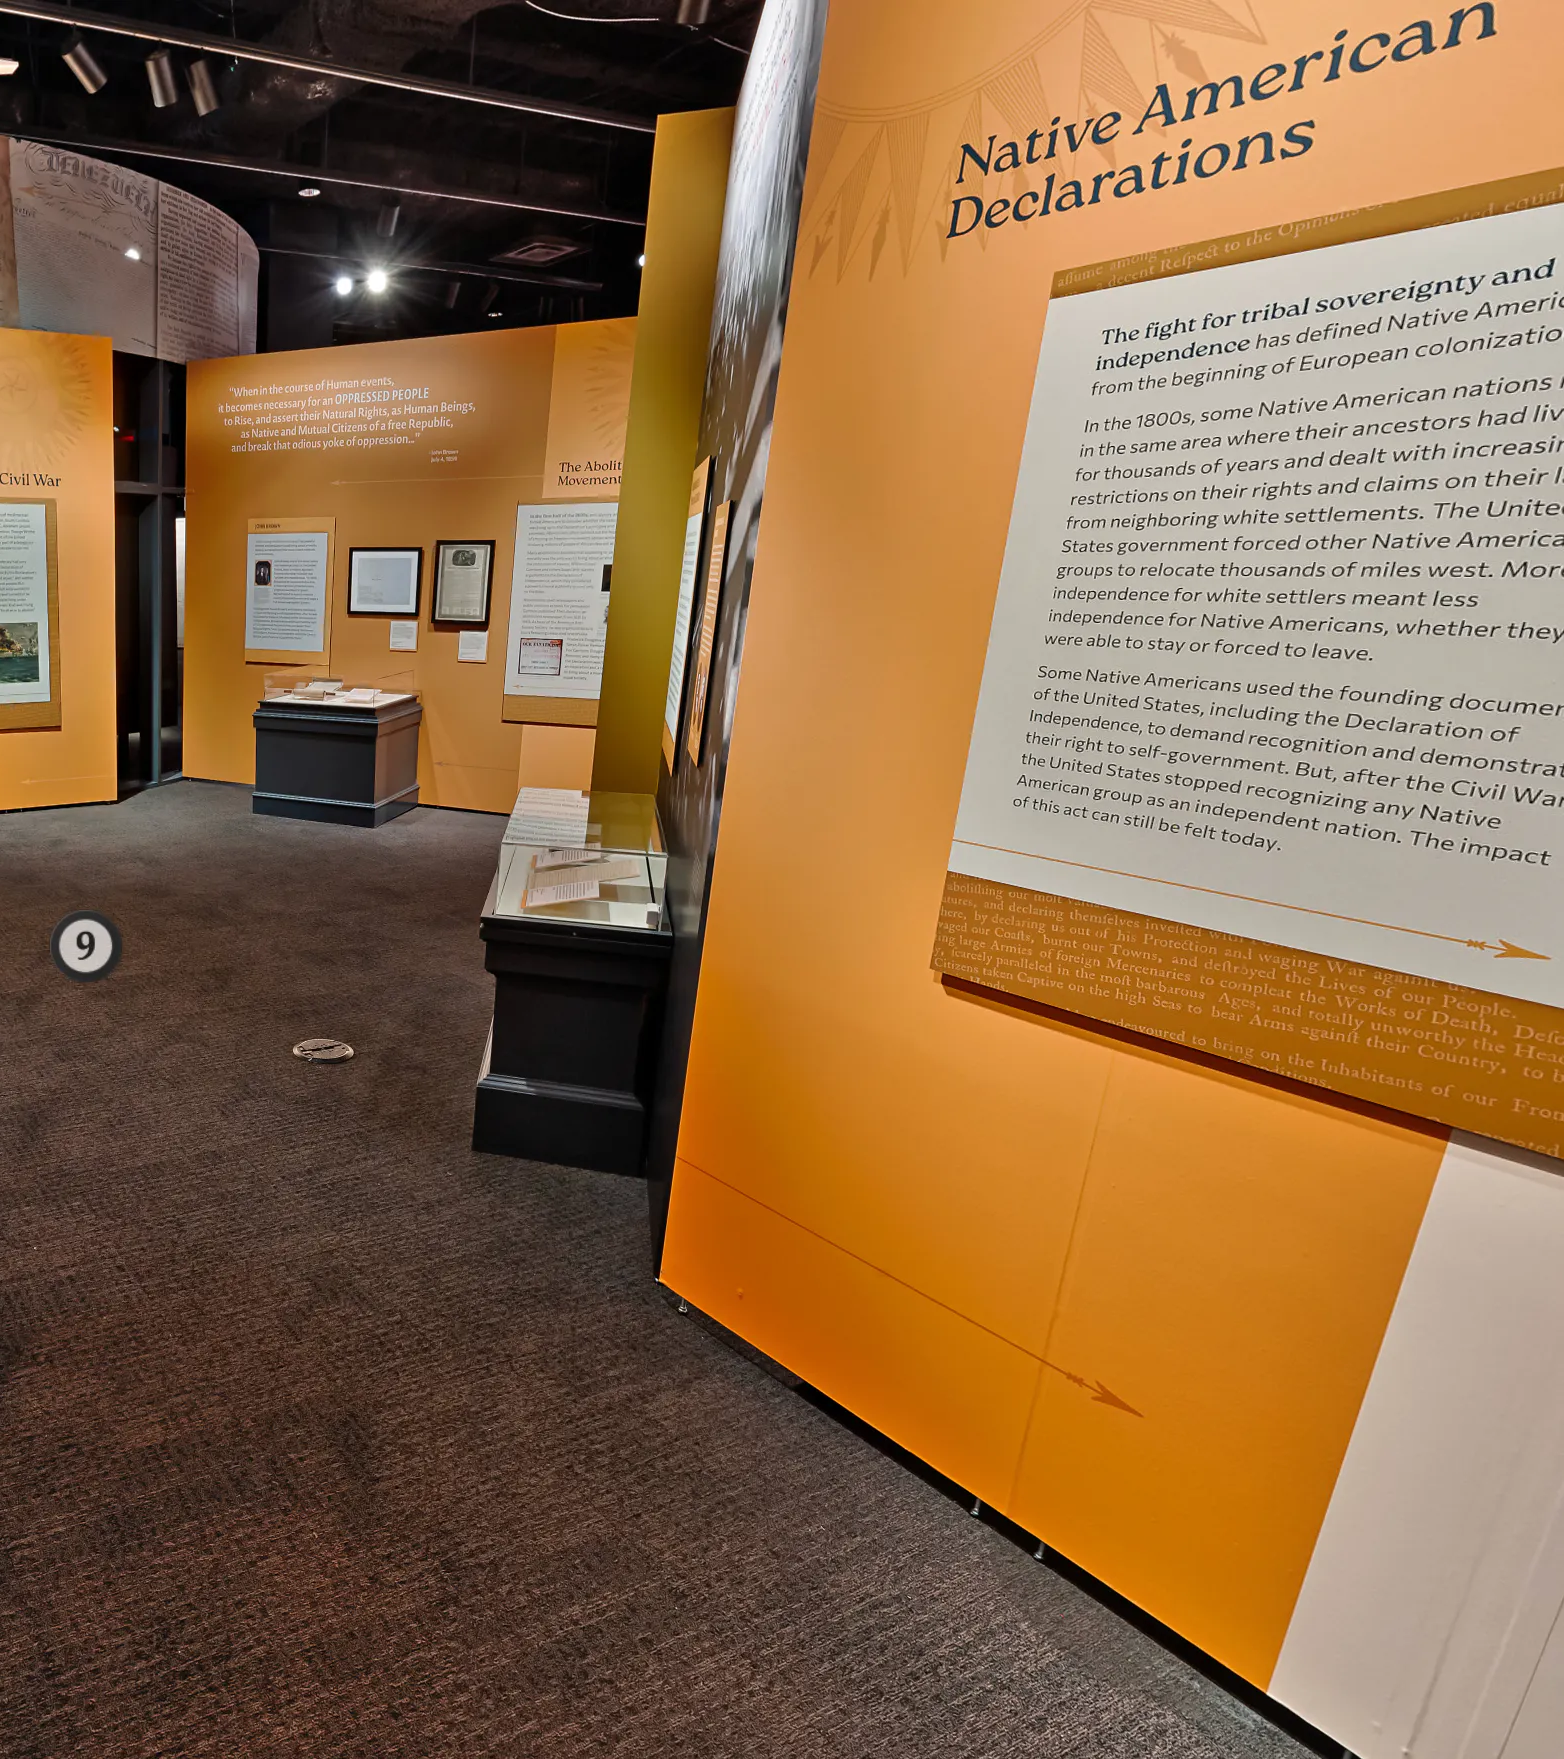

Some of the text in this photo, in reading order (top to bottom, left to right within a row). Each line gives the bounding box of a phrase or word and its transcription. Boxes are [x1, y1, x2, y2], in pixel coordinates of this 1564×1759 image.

[955, 2, 1497, 184] Native American
[946, 120, 1316, 239] Declarations
[1102, 257, 1556, 345] The fight for tribal sovereignty and
[259, 385, 268, 395] in
[269, 384, 283, 395] the
[284, 384, 314, 393] course
[315, 379, 326, 391] of
[326, 379, 359, 390] Human
[360, 377, 395, 387] events,
[218, 387, 430, 413] it becomes necessary for an OPPRESSED PEOPLE
[224, 400, 476, 426] to Rise, and assert their Natural Rights, as Human Beings,
[240, 431, 250, 439] as
[252, 427, 279, 438] Native
[280, 425, 296, 436] and
[298, 423, 330, 435] Mutual
[331, 422, 367, 433] Citizens
[369, 420, 380, 431] of
[387, 419, 407, 430] free
[408, 416, 454, 431] Republic,
[231, 441, 247, 452] and
[248, 440, 272, 452] break
[273, 440, 291, 450] that
[292, 439, 321, 449] odious
[322, 437, 344, 450] yoke
[346, 435, 357, 447] of
[558, 461, 582, 473] The
[31, 473, 62, 488] War
[557, 475, 622, 486] Movement
[1013, 796, 1282, 852] of this act can still be felt today.
